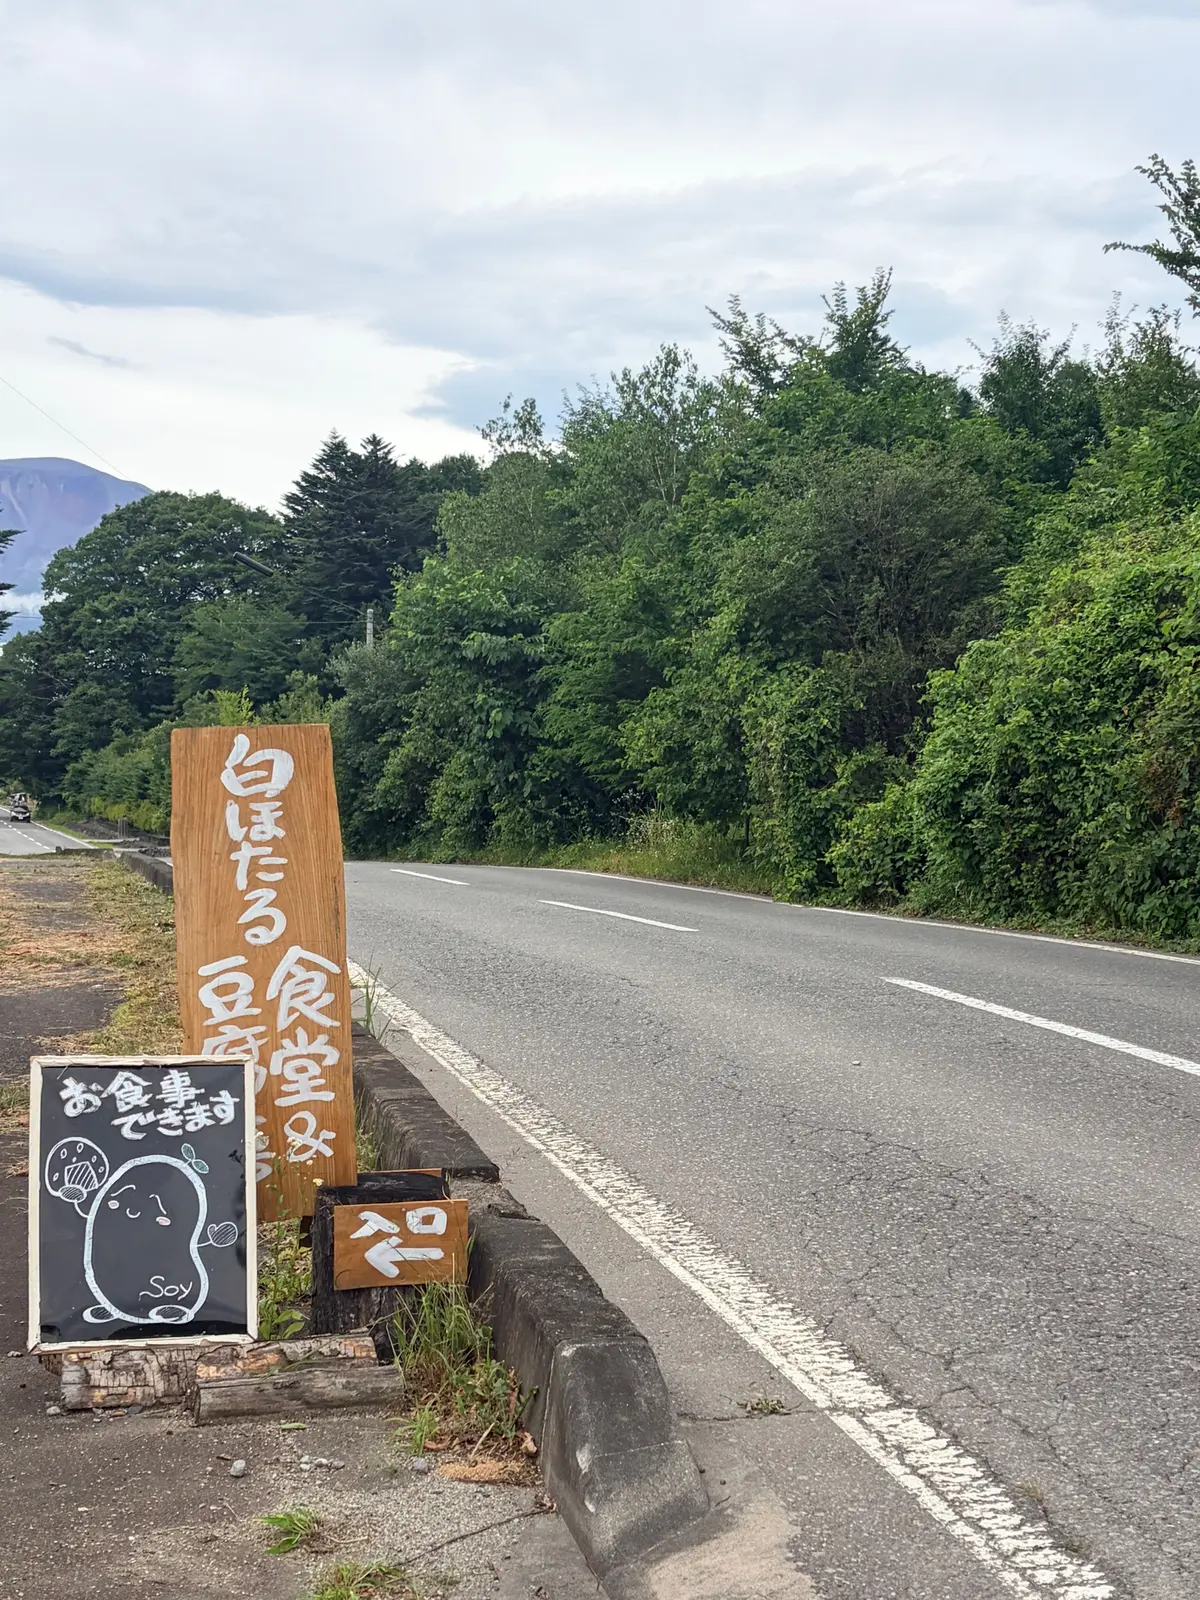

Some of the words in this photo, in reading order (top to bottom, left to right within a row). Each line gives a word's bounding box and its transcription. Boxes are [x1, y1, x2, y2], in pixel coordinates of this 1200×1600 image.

[220, 733, 295, 946] 白ほたる
[59, 1069, 205, 1118] お食事
[110, 1089, 240, 1141] できます
[349, 1206, 448, 1240] 入口
[138, 1275, 193, 1301] Soy
